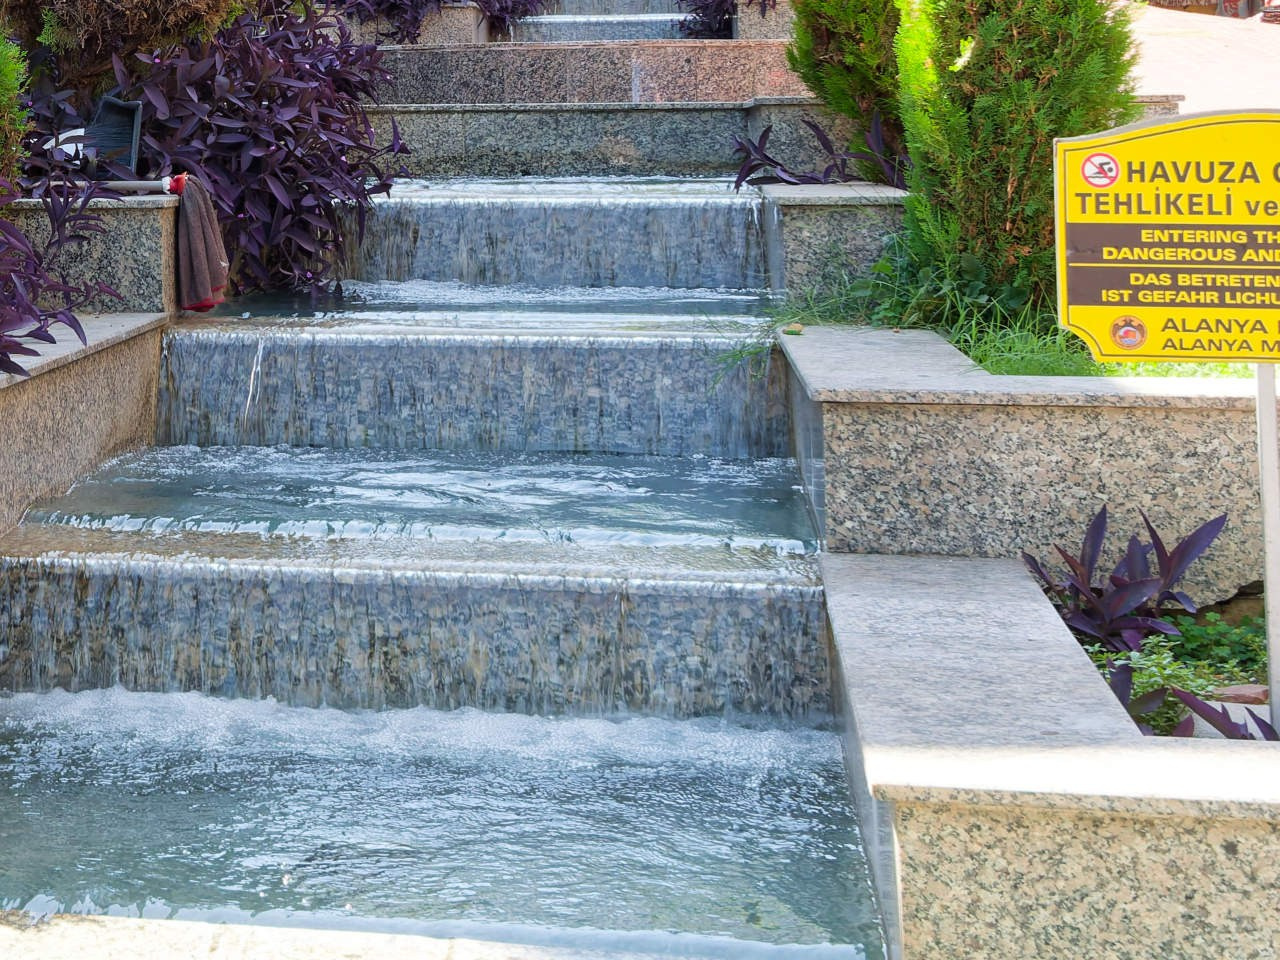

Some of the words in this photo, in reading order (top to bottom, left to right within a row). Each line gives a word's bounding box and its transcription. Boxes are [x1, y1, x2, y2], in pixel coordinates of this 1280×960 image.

[1127, 160, 1260, 184] HAVUZA
[1075, 186, 1233, 216] TEHLİKELİ
[1245, 200, 1278, 216] ve
[1141, 229, 1247, 244] ENTERING
[1102, 247, 1236, 262] DANGEROUS
[1129, 272, 1171, 287] DAS
[1101, 289, 1132, 303] IST
[1138, 290, 1219, 304] GEFAHR
[1161, 317, 1267, 334] ALANYA
[1162, 338, 1253, 352] ALANYA
